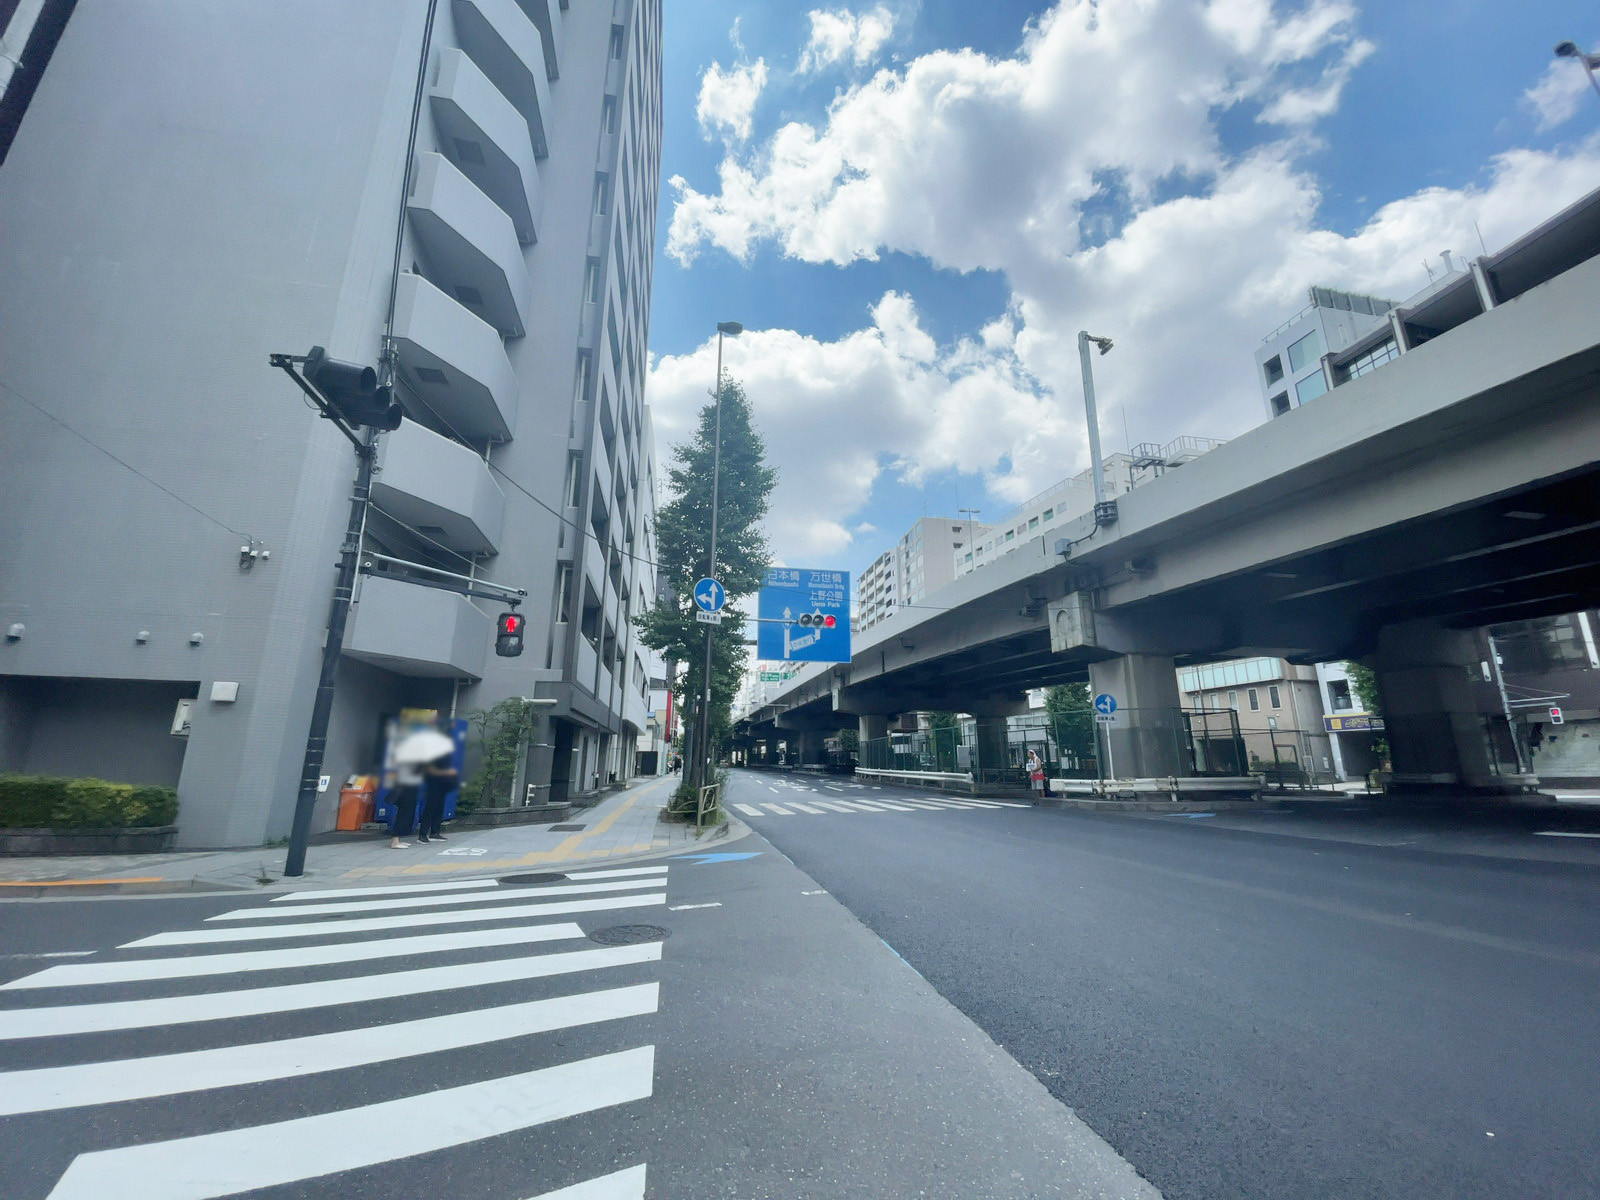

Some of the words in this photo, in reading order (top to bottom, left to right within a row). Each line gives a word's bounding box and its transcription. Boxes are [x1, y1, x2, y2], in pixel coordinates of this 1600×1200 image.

[768, 570, 800, 581] 日本橋
[810, 572, 842, 583] 万世橋
[809, 590, 843, 602] 上野公園
